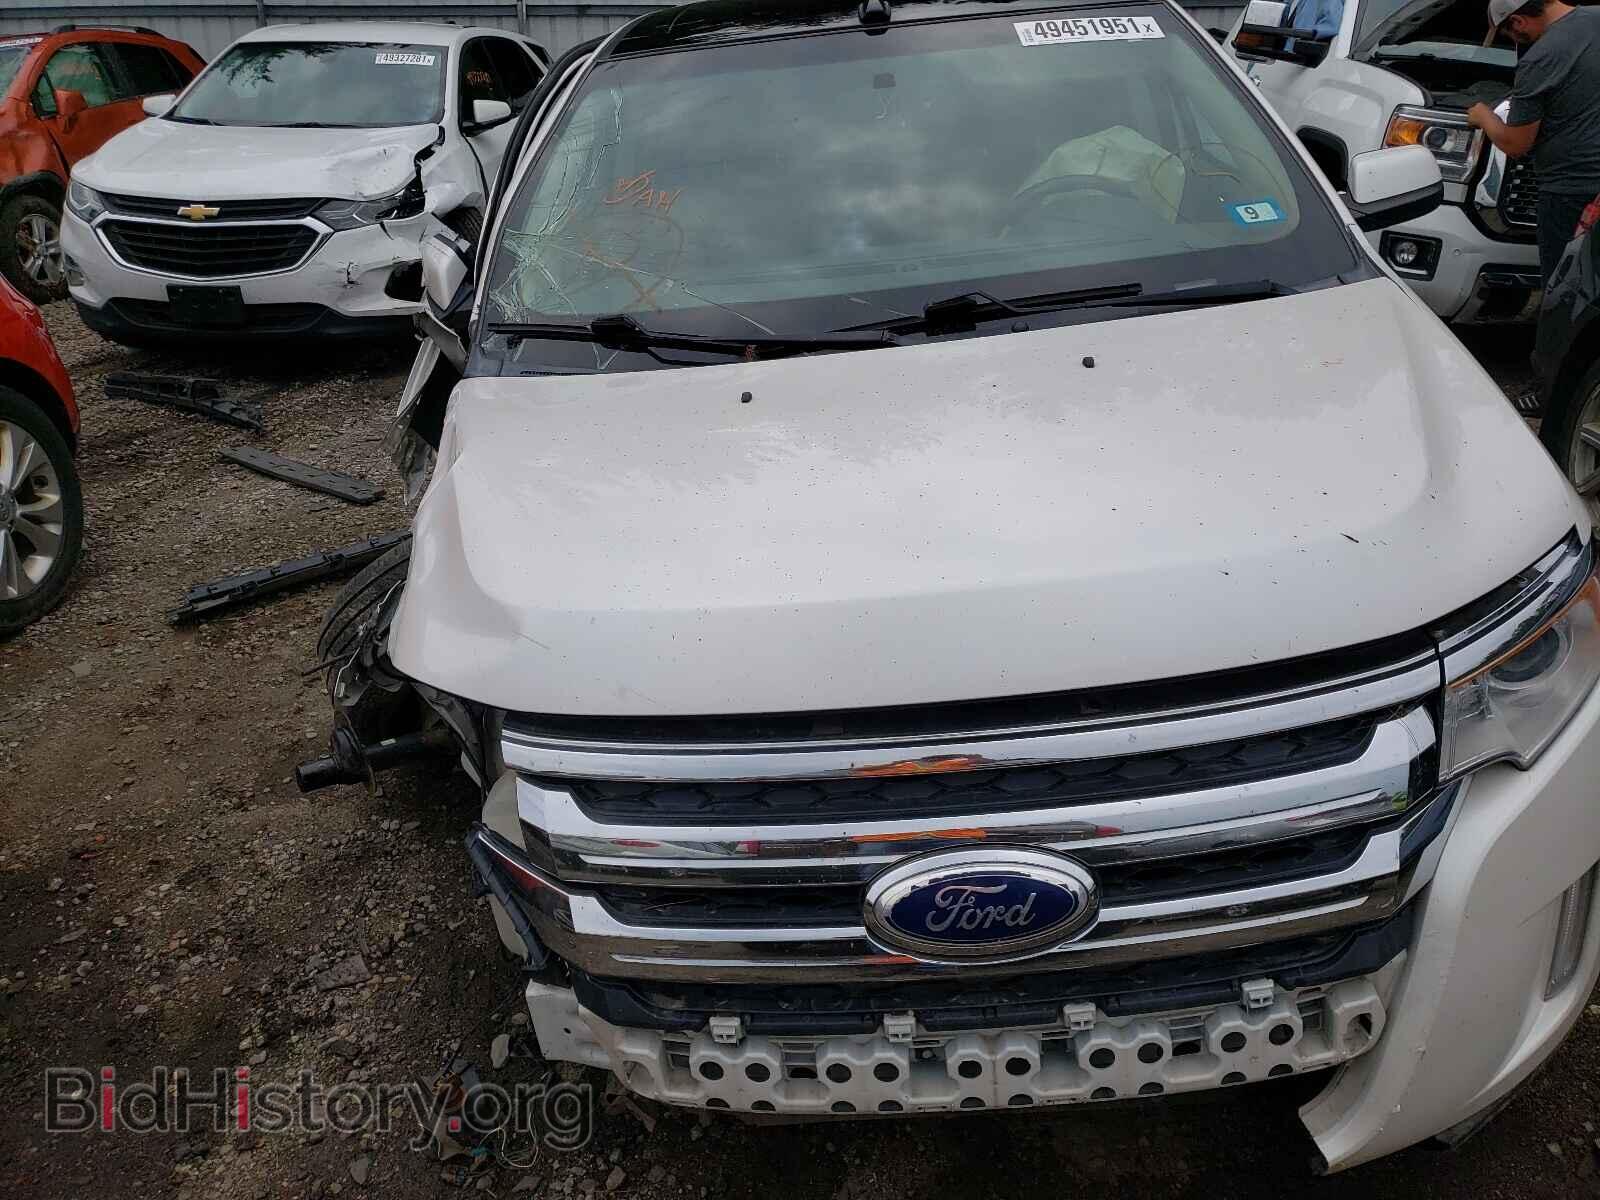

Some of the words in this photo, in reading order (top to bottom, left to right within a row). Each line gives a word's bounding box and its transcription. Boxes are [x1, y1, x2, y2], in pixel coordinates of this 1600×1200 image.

[1034, 17, 1141, 38] 49451951
[1244, 206, 1260, 220] 9
[926, 884, 1037, 932] Ford
